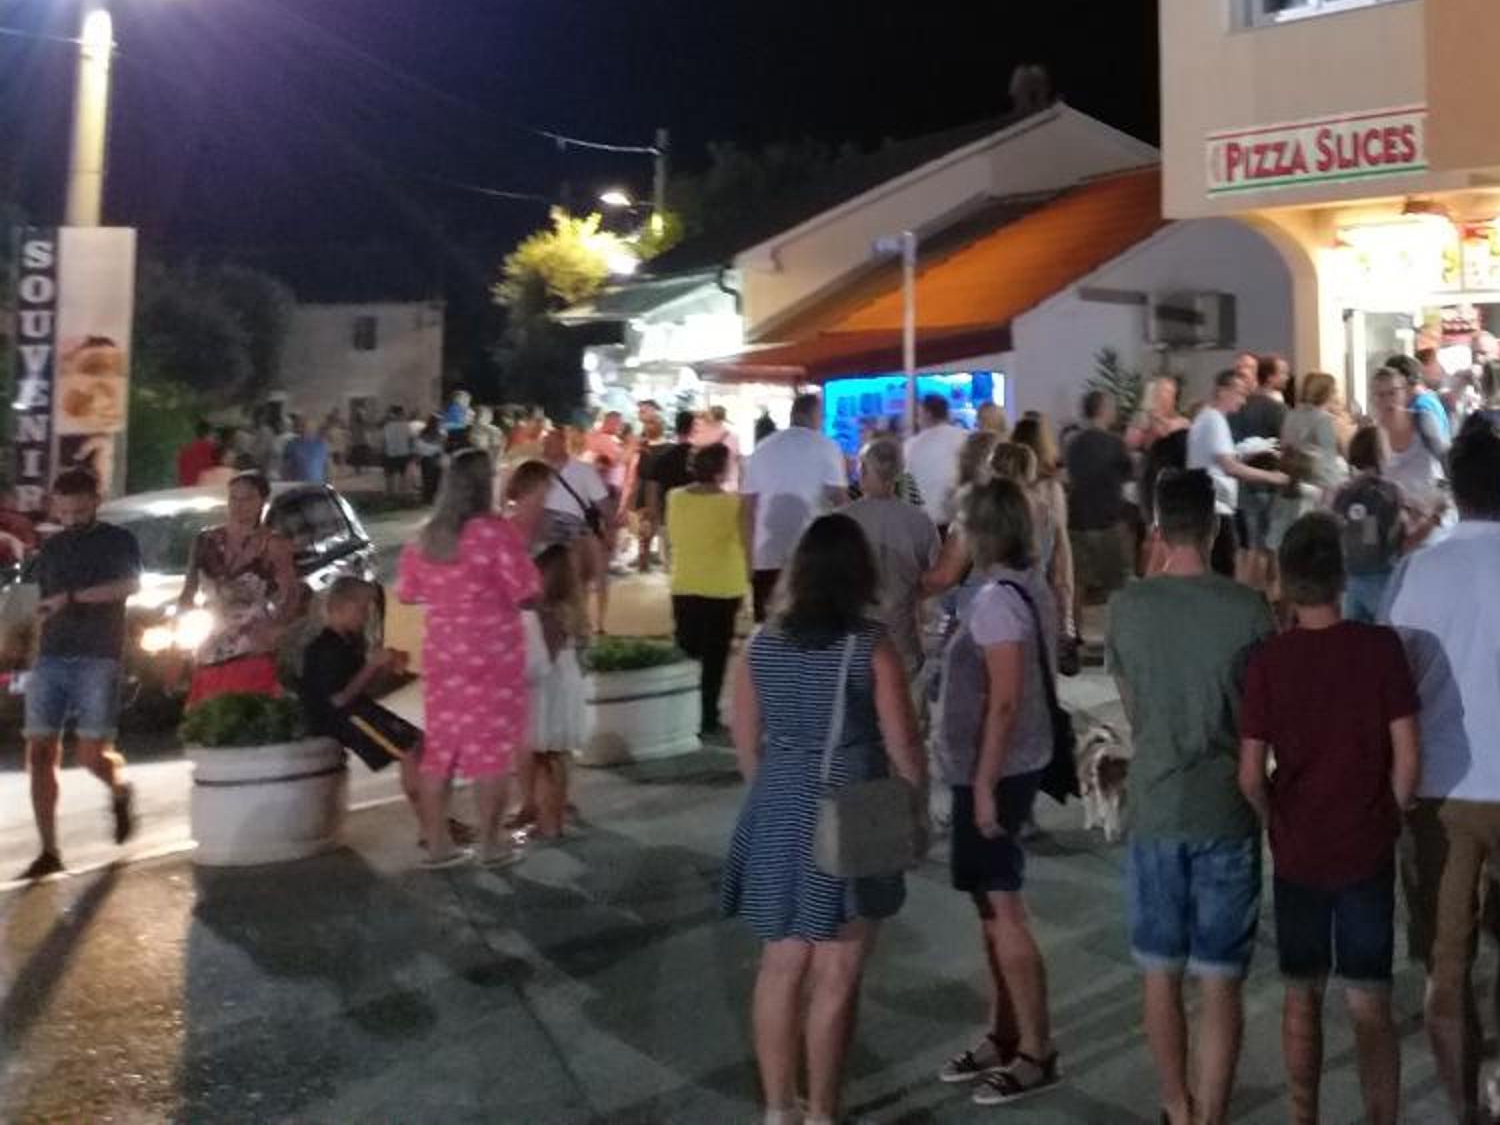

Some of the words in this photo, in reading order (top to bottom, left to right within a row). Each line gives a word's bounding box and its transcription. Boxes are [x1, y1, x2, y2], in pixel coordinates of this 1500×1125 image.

[1225, 141, 1309, 183] PIZZA
[1315, 124, 1417, 173] SLICES
[15, 241, 55, 513] SOUVENIR
